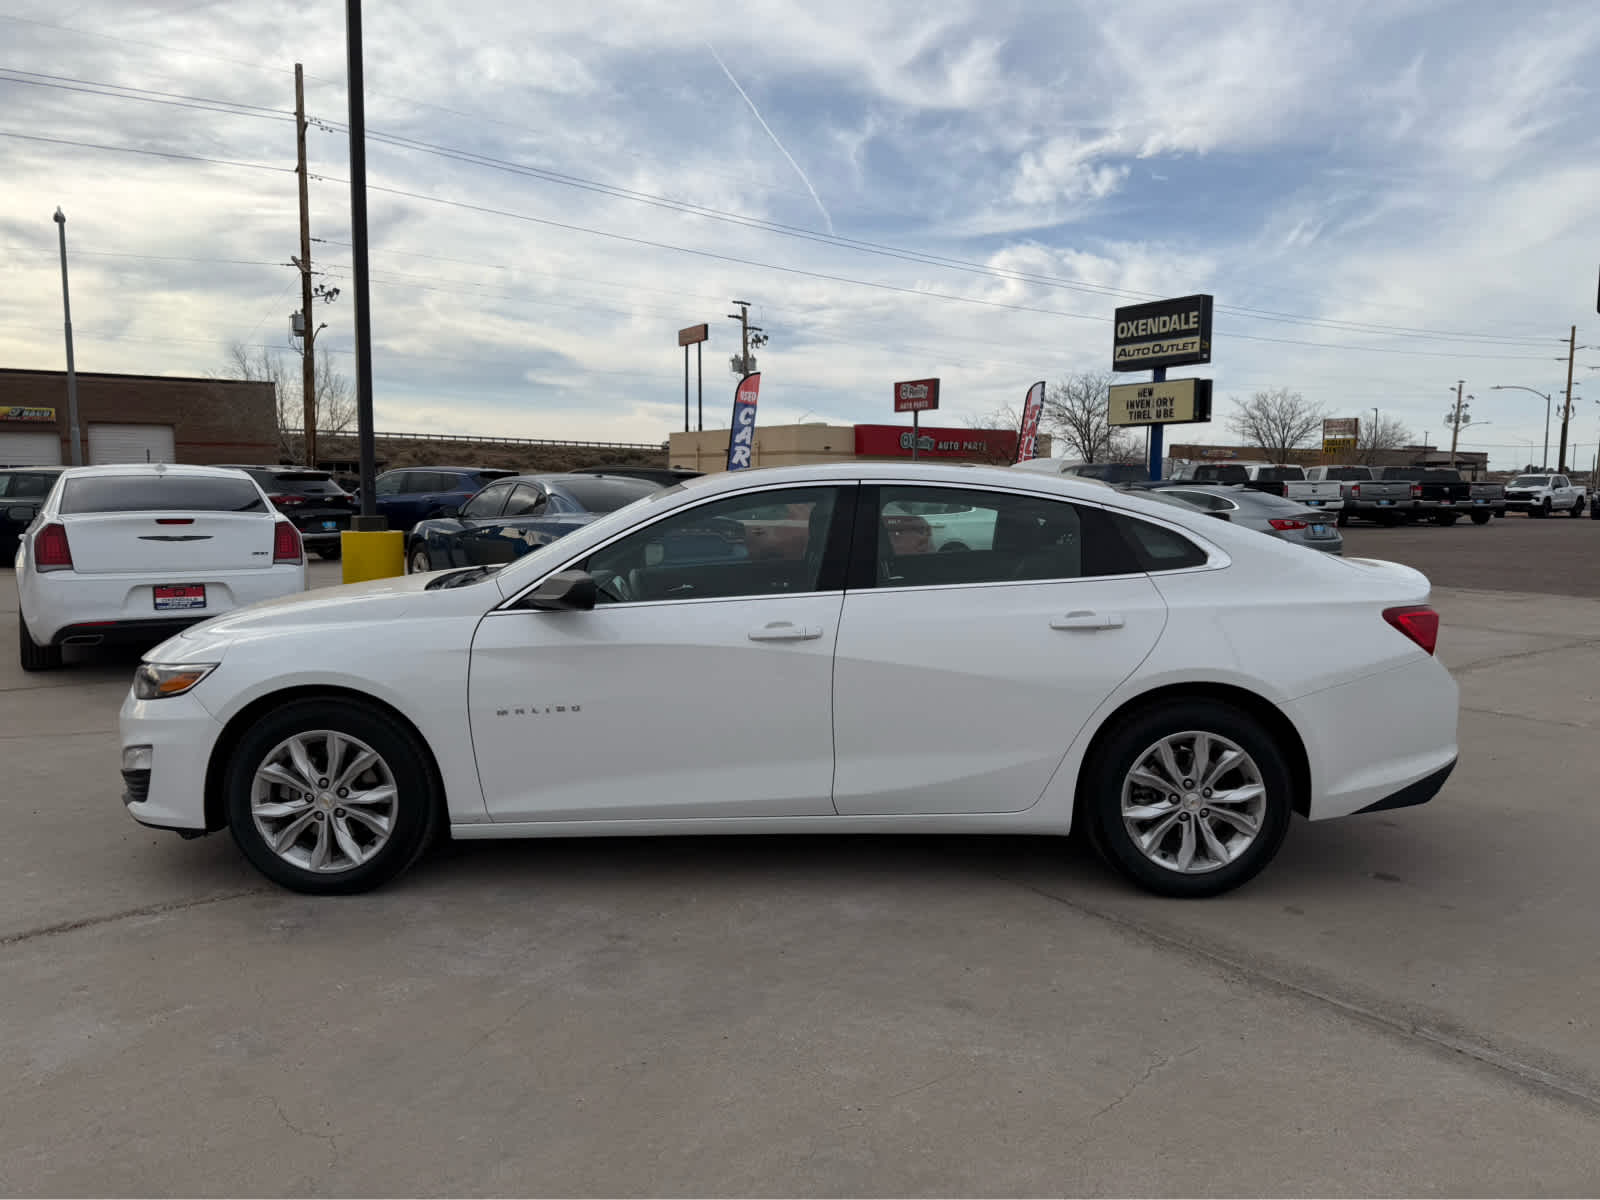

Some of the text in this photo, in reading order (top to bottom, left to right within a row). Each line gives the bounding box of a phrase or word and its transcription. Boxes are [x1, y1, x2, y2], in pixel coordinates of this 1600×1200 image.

[1117, 312, 1199, 338] OXENDALE
[1117, 341, 1197, 359] AUTO OUTLET
[1126, 397, 1174, 409] INVENORY
[938, 441, 959, 450] AUTO
[496, 705, 580, 716] MALIBU
